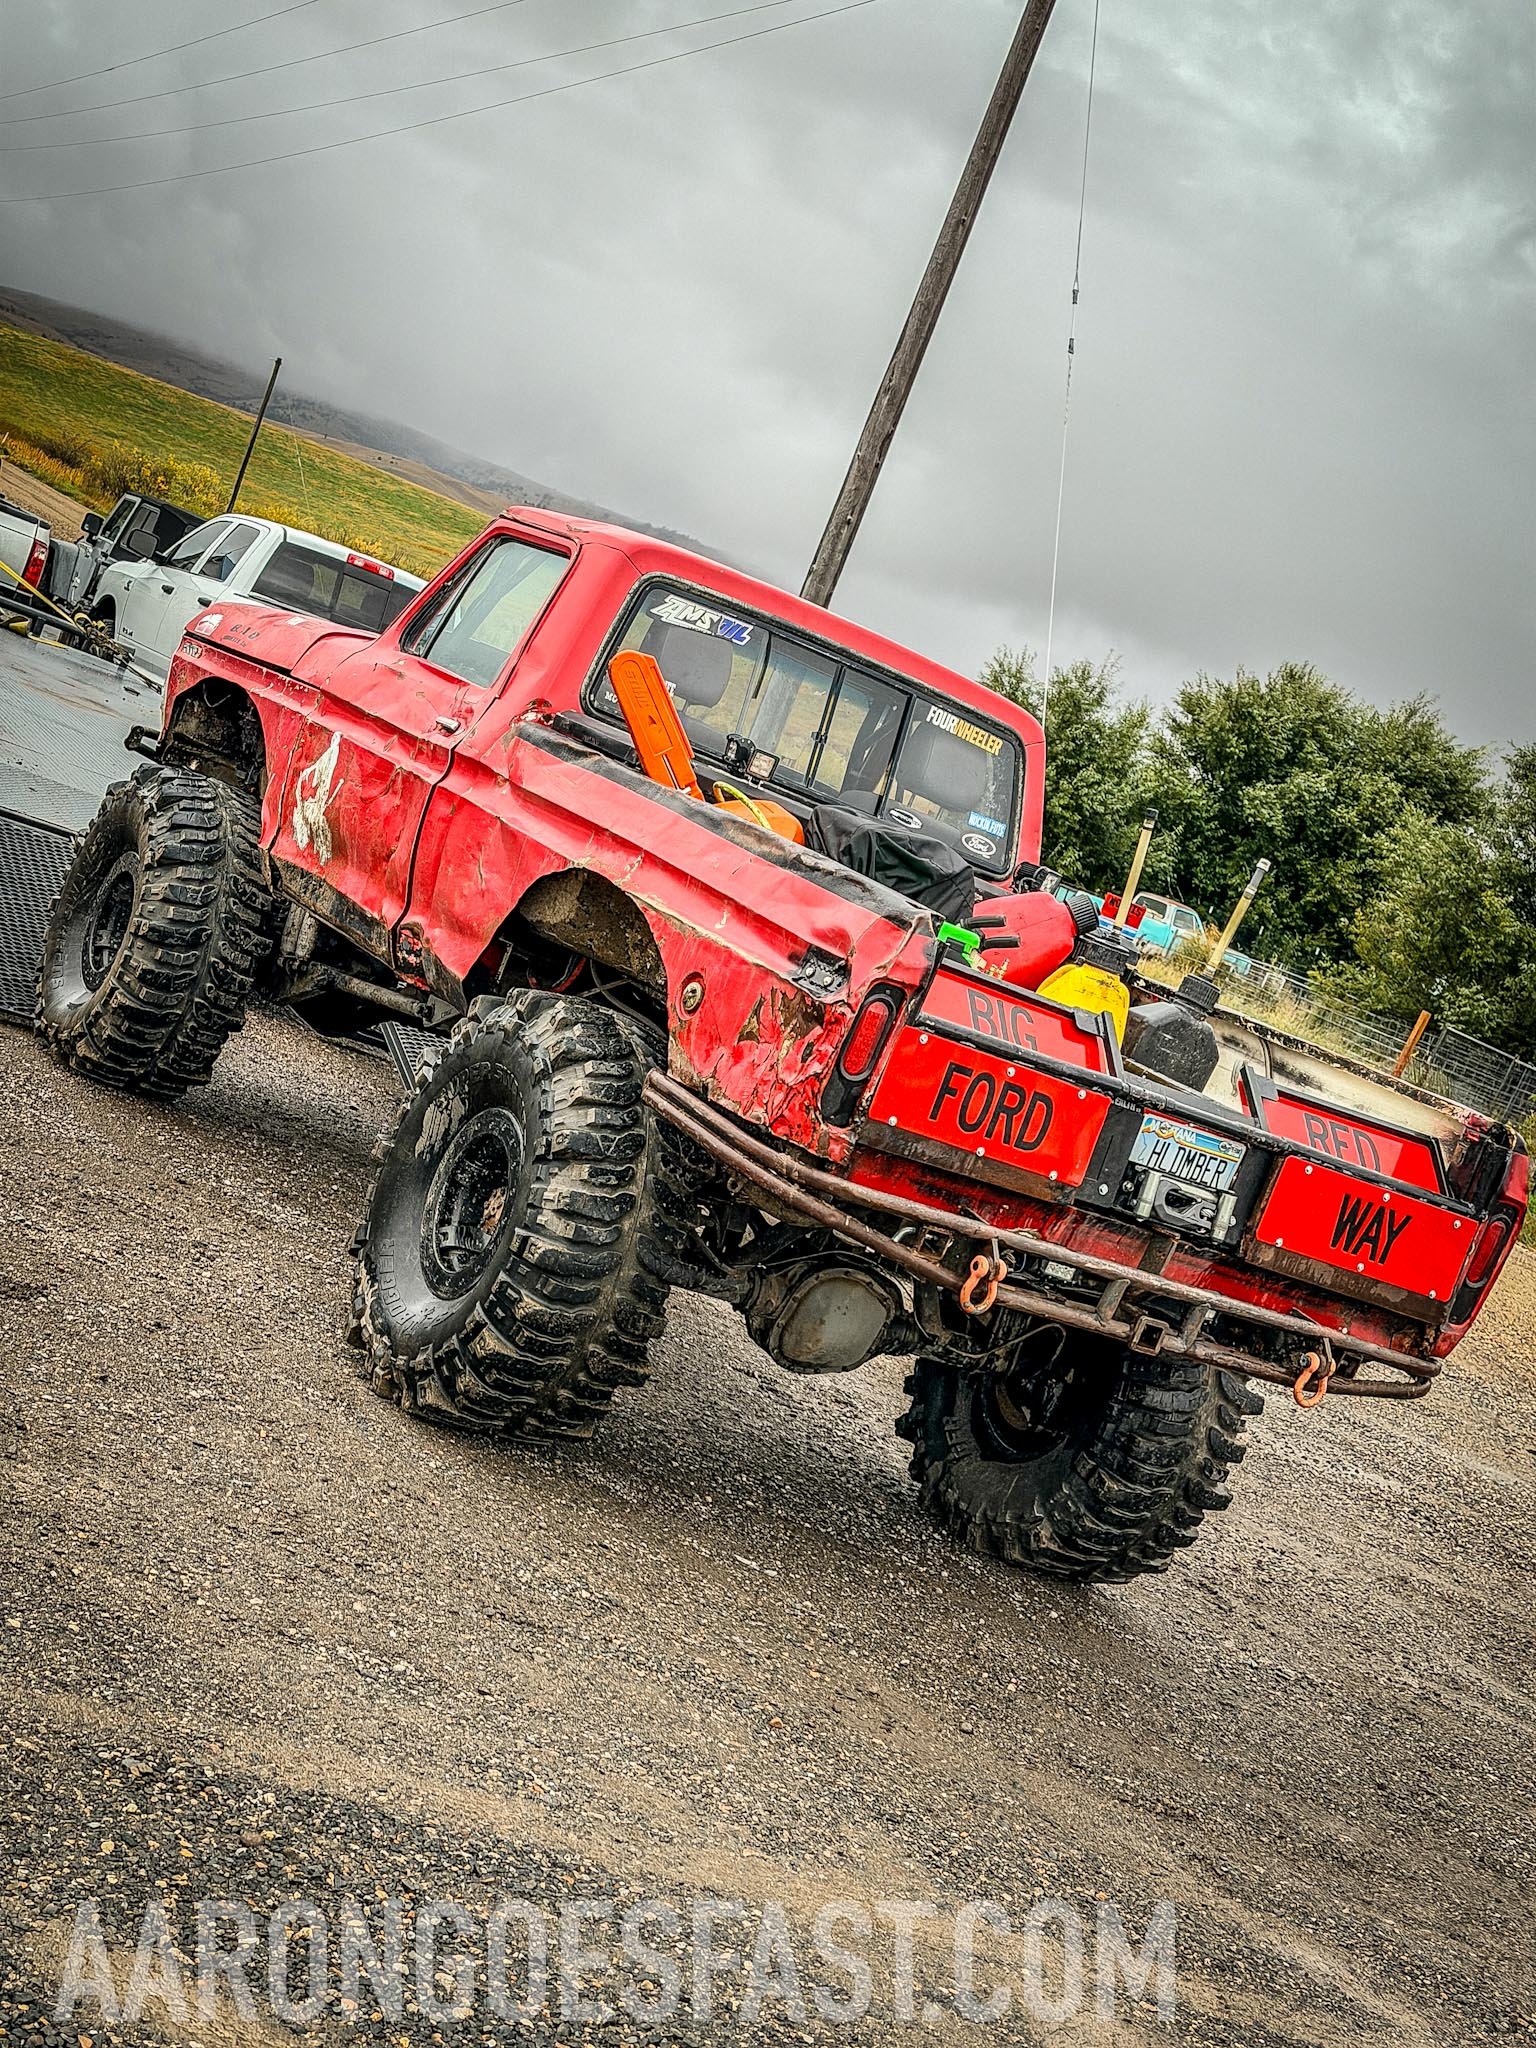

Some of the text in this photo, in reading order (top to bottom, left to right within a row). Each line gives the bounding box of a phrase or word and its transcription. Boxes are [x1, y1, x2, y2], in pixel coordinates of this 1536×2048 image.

[650, 594, 754, 646] AMSOIL
[967, 988, 1039, 1052] BIG
[928, 1060, 1055, 1153] FORD
[1150, 1118, 1197, 1144] MTANA
[1330, 1193, 1413, 1266] WAY
